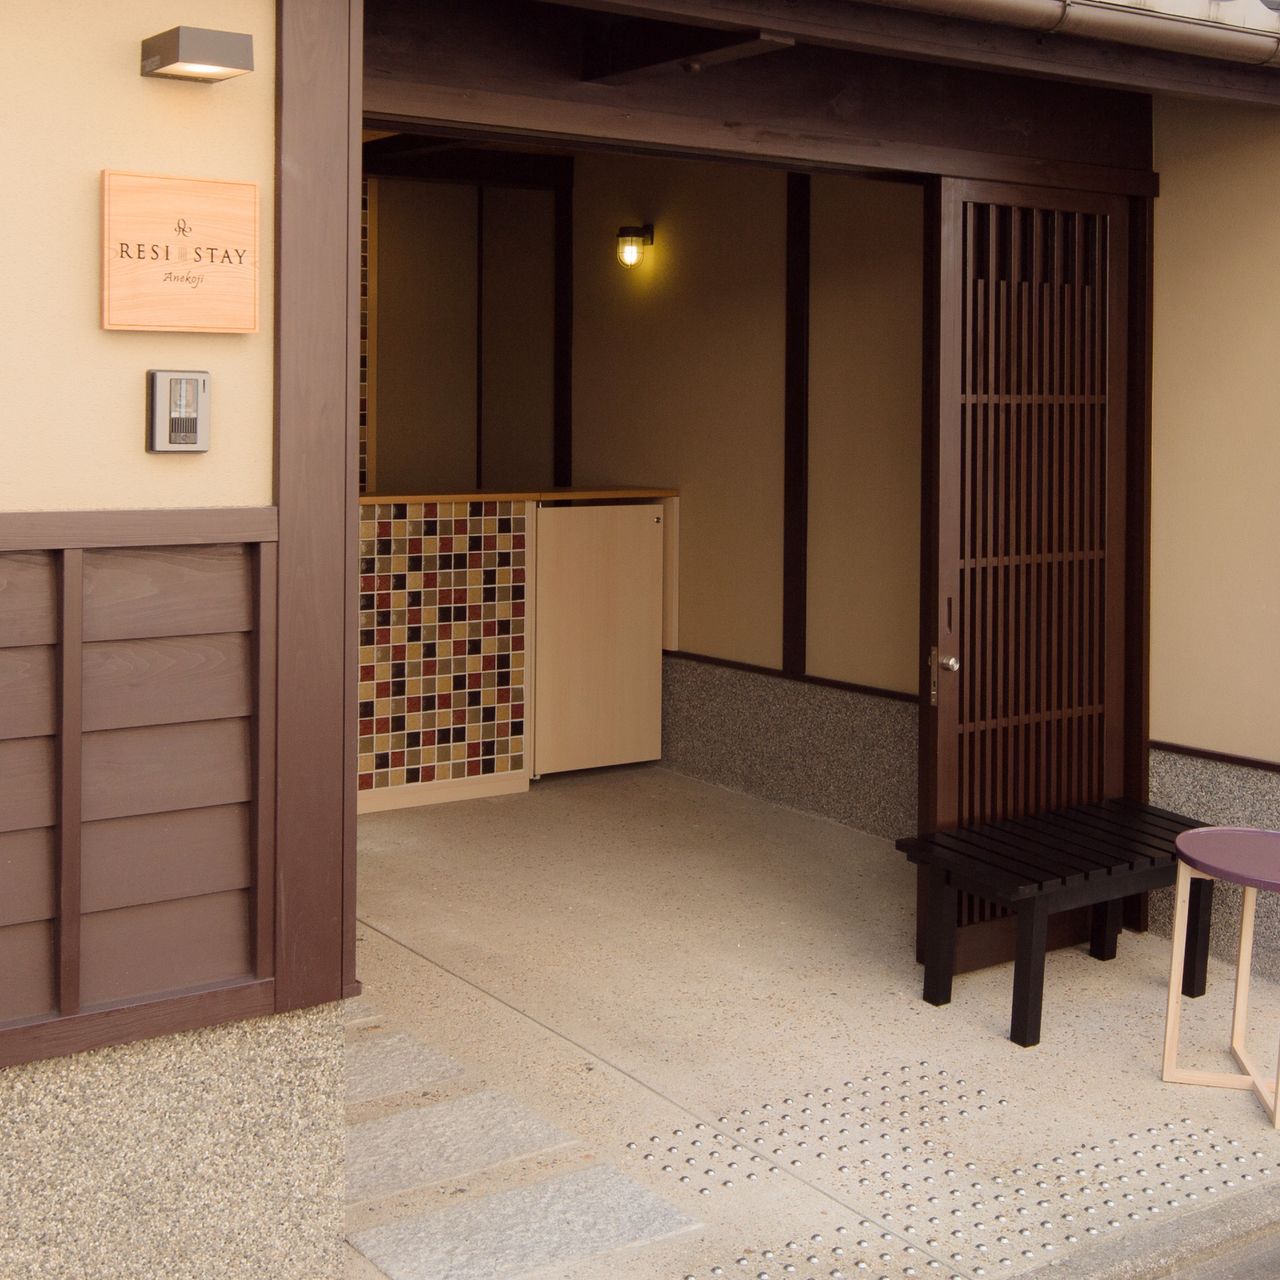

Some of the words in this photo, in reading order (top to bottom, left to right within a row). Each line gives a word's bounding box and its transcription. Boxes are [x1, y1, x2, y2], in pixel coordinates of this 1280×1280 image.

[119, 242, 170, 261] RESI
[193, 246, 247, 265] STAY
[162, 271, 205, 289] Anekoji
